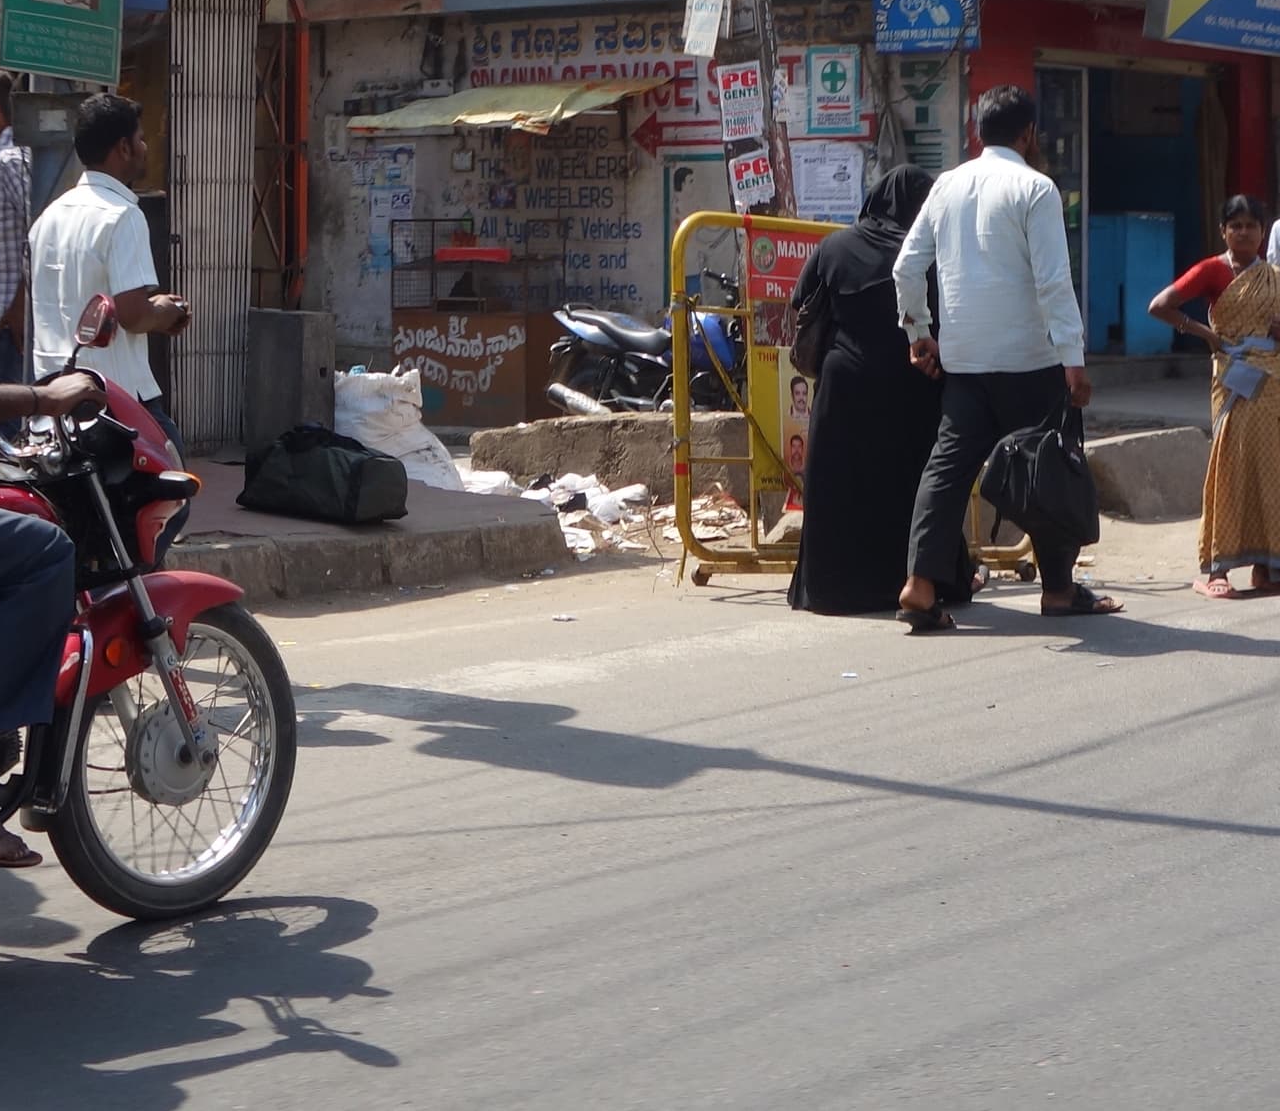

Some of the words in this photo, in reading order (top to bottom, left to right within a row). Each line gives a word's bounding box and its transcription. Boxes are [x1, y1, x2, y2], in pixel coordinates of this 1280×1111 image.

[721, 69, 758, 91] PG
[723, 87, 760, 101] GENTS
[733, 156, 771, 181] PG
[736, 174, 772, 191] GENTS
[524, 186, 614, 210] WHEELERS
[479, 217, 498, 239] All
[580, 216, 642, 239] Vehicles
[599, 248, 628, 269] and
[599, 277, 643, 302] Here.
